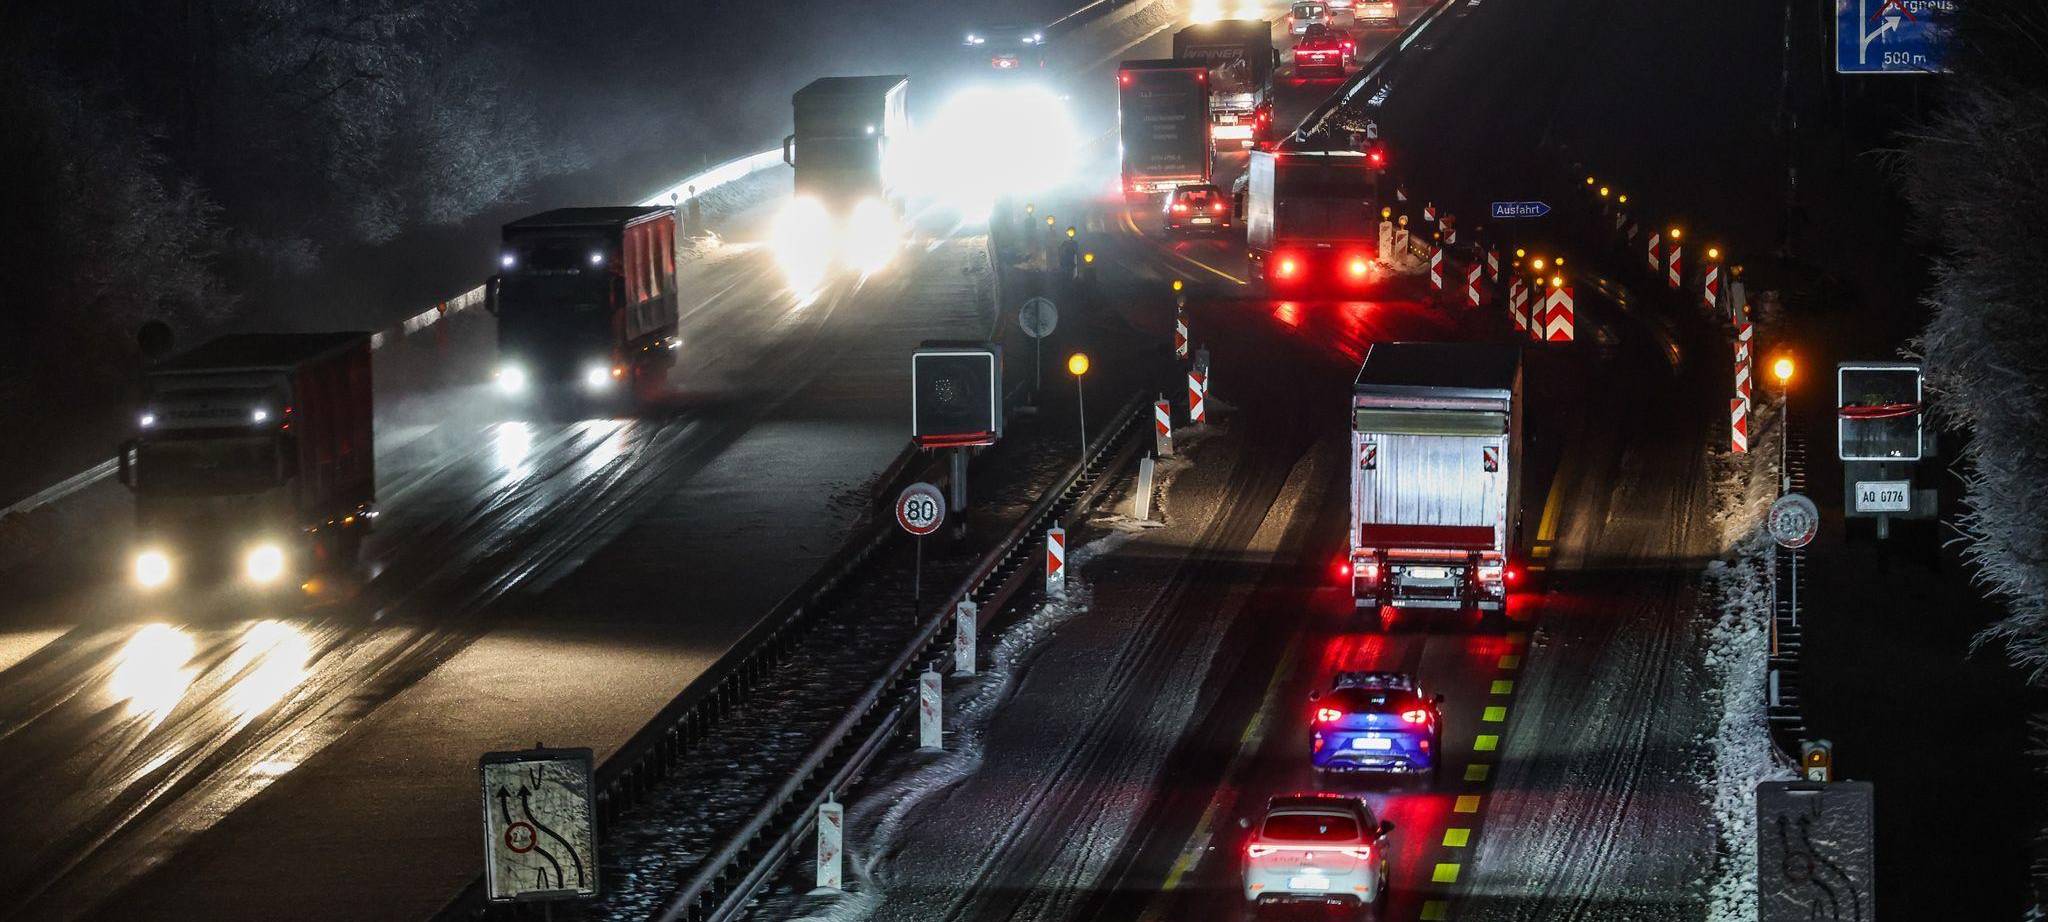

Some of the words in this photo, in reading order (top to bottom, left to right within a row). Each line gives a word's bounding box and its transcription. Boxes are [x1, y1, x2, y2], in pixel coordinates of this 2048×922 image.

[1884, 52, 1910, 64] 500
[1913, 54, 1926, 63] m
[1497, 205, 1539, 215] Ausfahrt
[1863, 491, 1876, 502] AQ
[908, 500, 933, 520] 80
